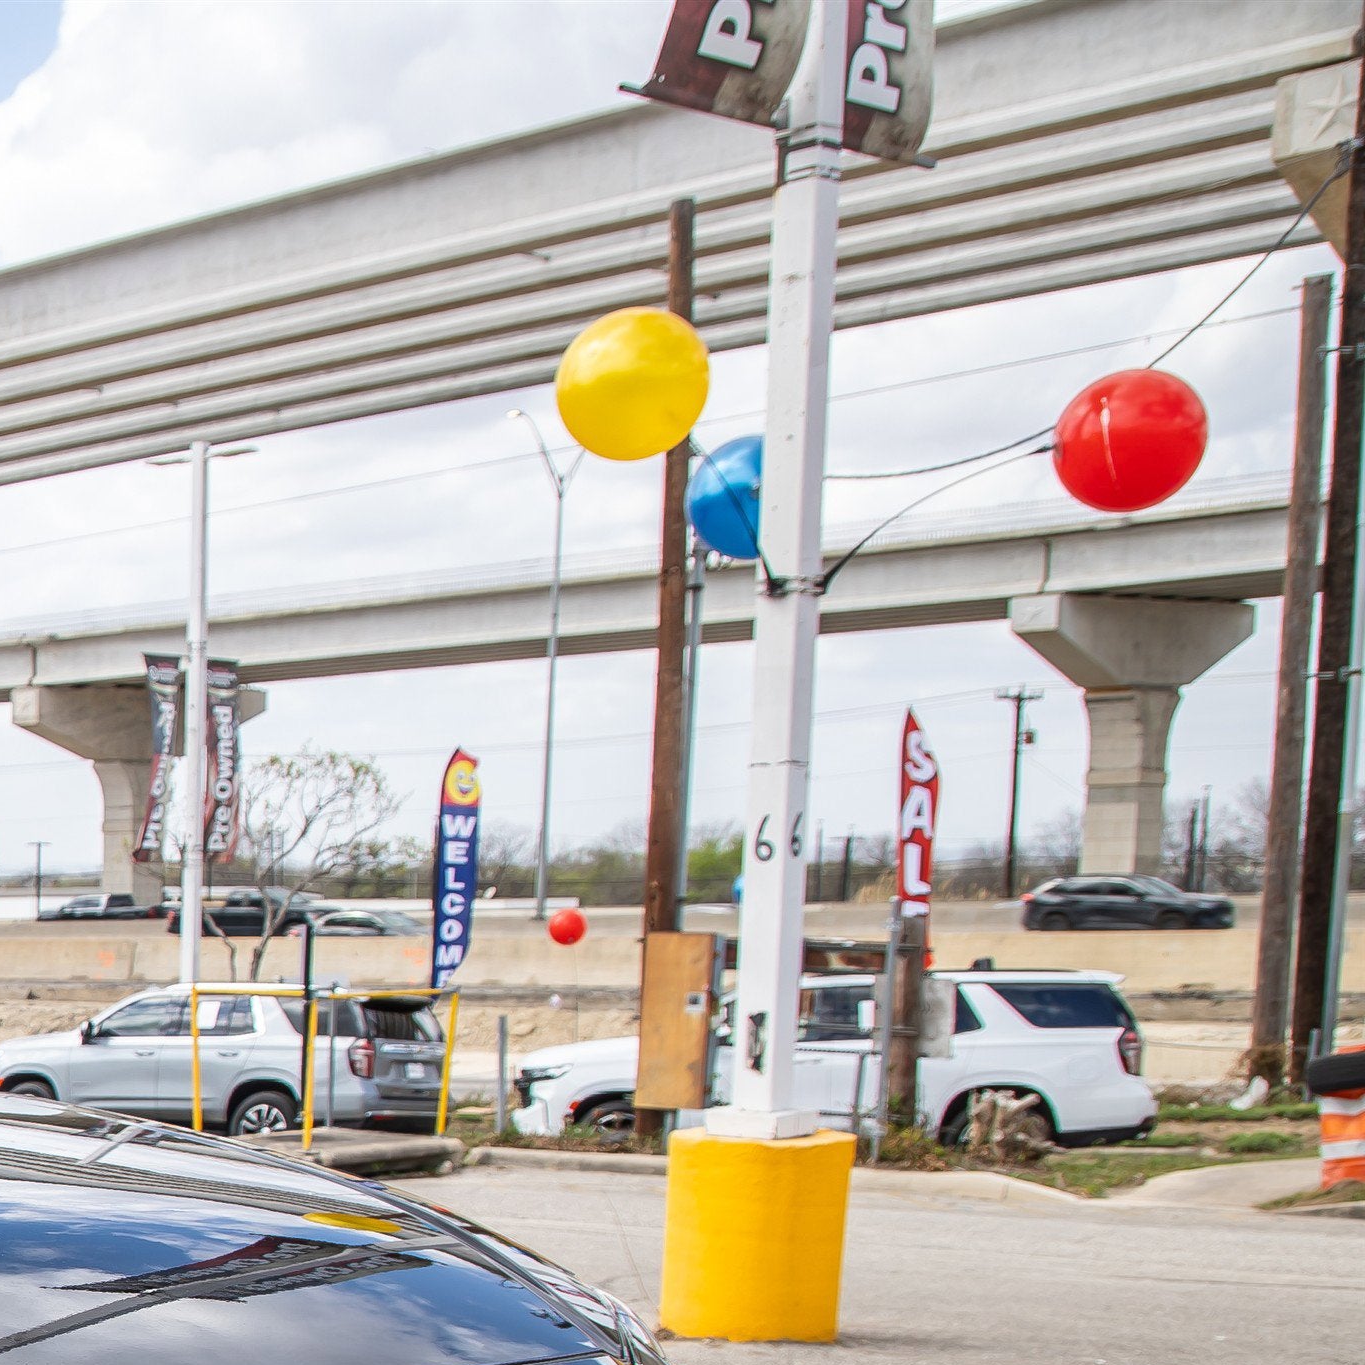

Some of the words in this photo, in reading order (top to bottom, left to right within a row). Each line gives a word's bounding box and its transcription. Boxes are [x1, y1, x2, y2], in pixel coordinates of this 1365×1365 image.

[846, 0, 907, 113] Pr
[212, 704, 234, 801] Owned
[205, 805, 232, 852] Pre
[755, 813, 776, 863] 6
[790, 811, 804, 858] 6
